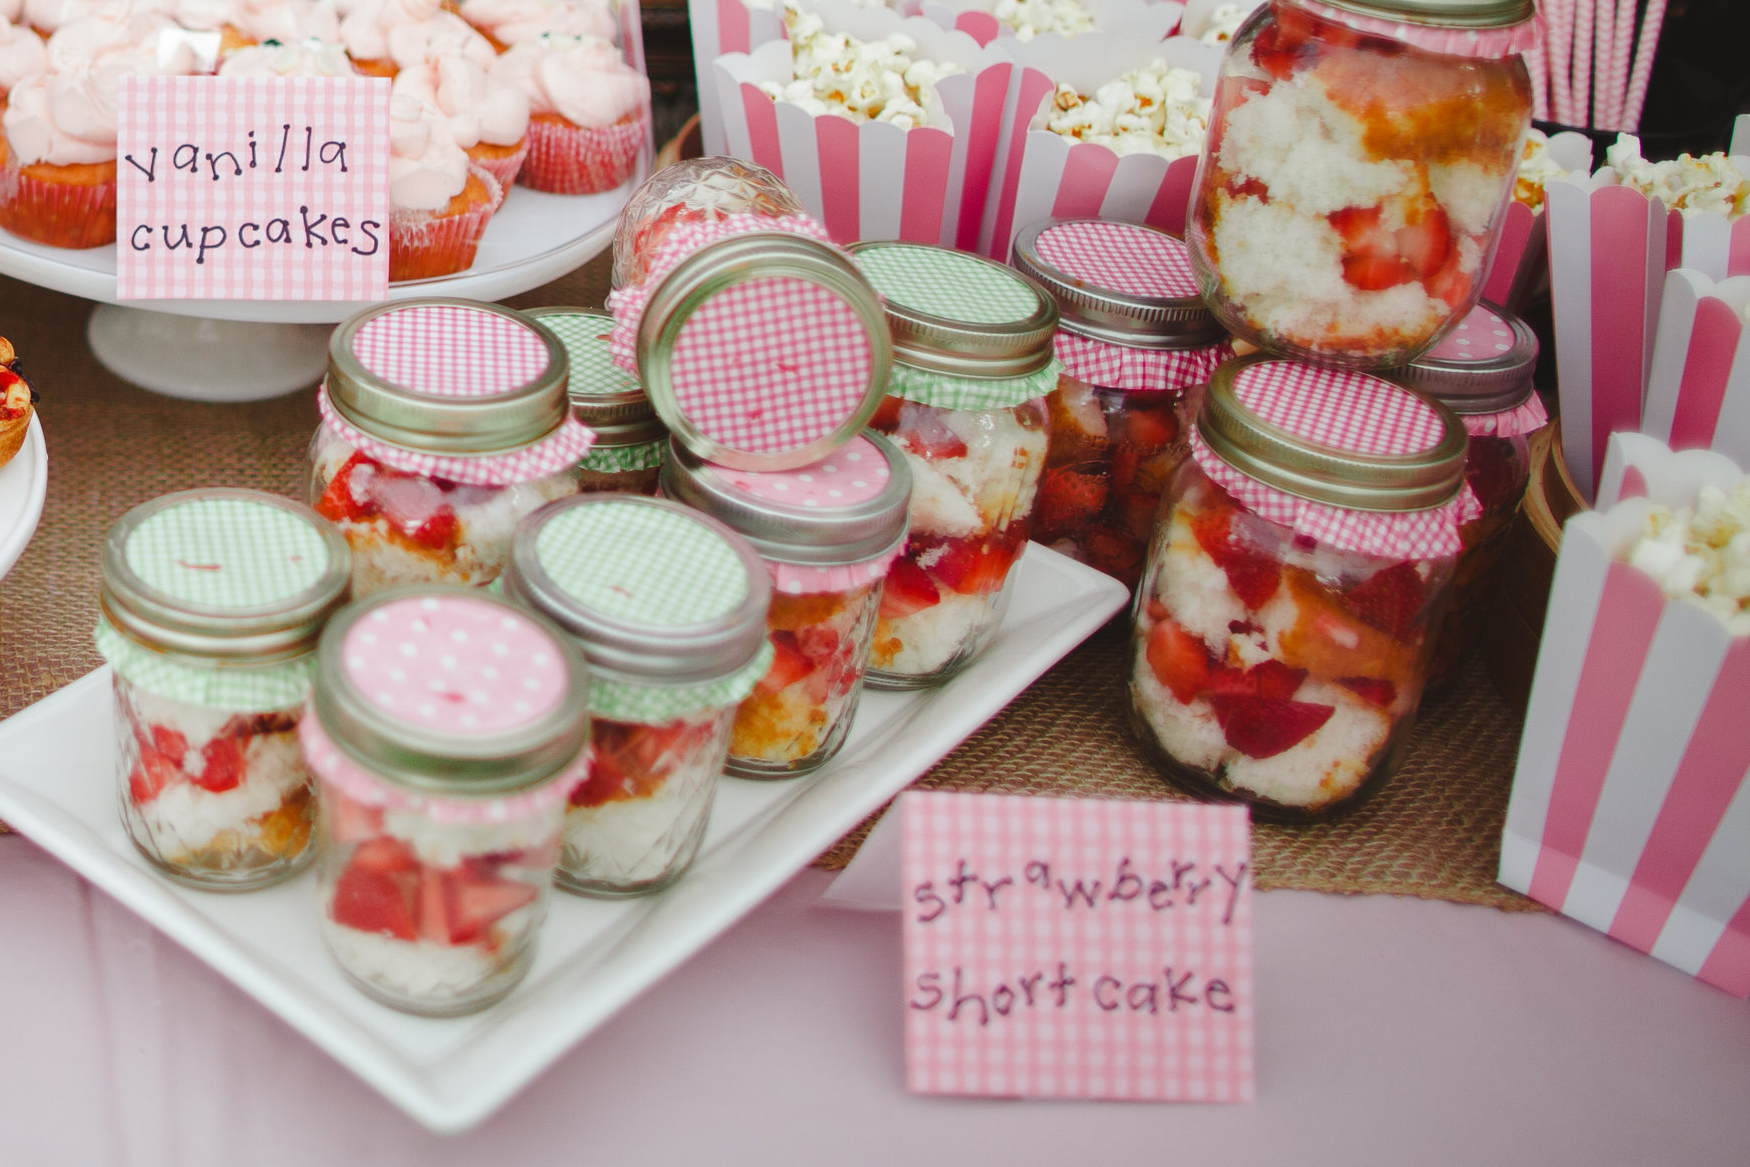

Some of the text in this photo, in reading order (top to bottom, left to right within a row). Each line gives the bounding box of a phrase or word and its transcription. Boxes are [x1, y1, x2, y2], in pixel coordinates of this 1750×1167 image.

[125, 123, 348, 182] vanilla
[131, 205, 381, 265] cupcakes
[913, 856, 1248, 925] strawberry
